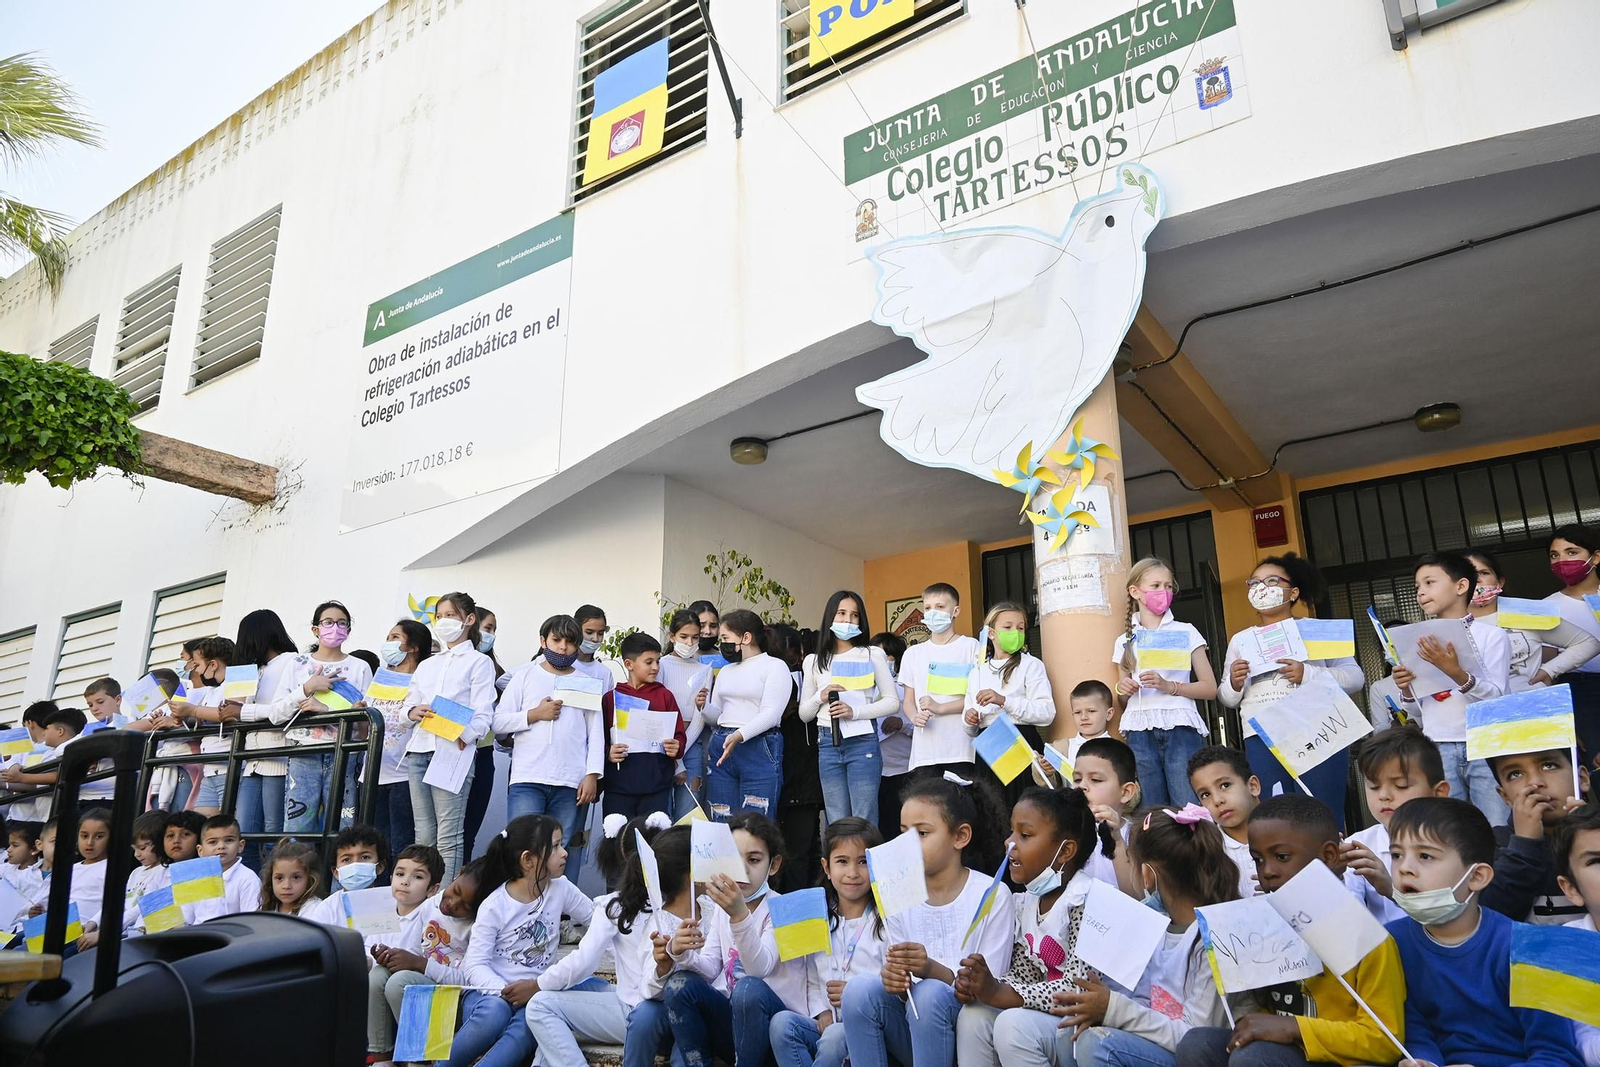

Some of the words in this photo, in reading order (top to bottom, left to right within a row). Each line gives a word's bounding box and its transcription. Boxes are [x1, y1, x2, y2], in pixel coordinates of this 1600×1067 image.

[818, 0, 893, 37] PO
[863, 103, 942, 153] JUNTA
[971, 74, 1006, 106] DE
[883, 128, 948, 162] CONSEJERIA
[967, 112, 981, 128] DE
[1000, 77, 1065, 114] EDUCACION
[1091, 62, 1099, 75] Y
[1126, 31, 1179, 61] CIENCIA
[887, 135, 1004, 202] Colegio
[1042, 64, 1180, 143] Público
[933, 122, 1129, 223] TARTESSOS
[496, 234, 562, 269] www.juntadeandalucia.es
[388, 305, 405, 319] Junta
[405, 301, 413, 310] de
[413, 286, 444, 307] Andalucía
[364, 358, 441, 402] refrigeración
[445, 329, 518, 370] adiabática
[522, 320, 541, 340] en
[546, 307, 561, 331] el
[368, 352, 396, 375] Obra
[400, 343, 416, 362] de
[419, 311, 491, 354] instalación
[495, 302, 513, 322] de
[361, 399, 405, 428] Colegio
[409, 375, 471, 410] Tartessos
[352, 469, 396, 493] Inversión:
[400, 445, 463, 478] 177.018,18
[465, 441, 474, 457] €
[1255, 510, 1280, 520] FUEGO
